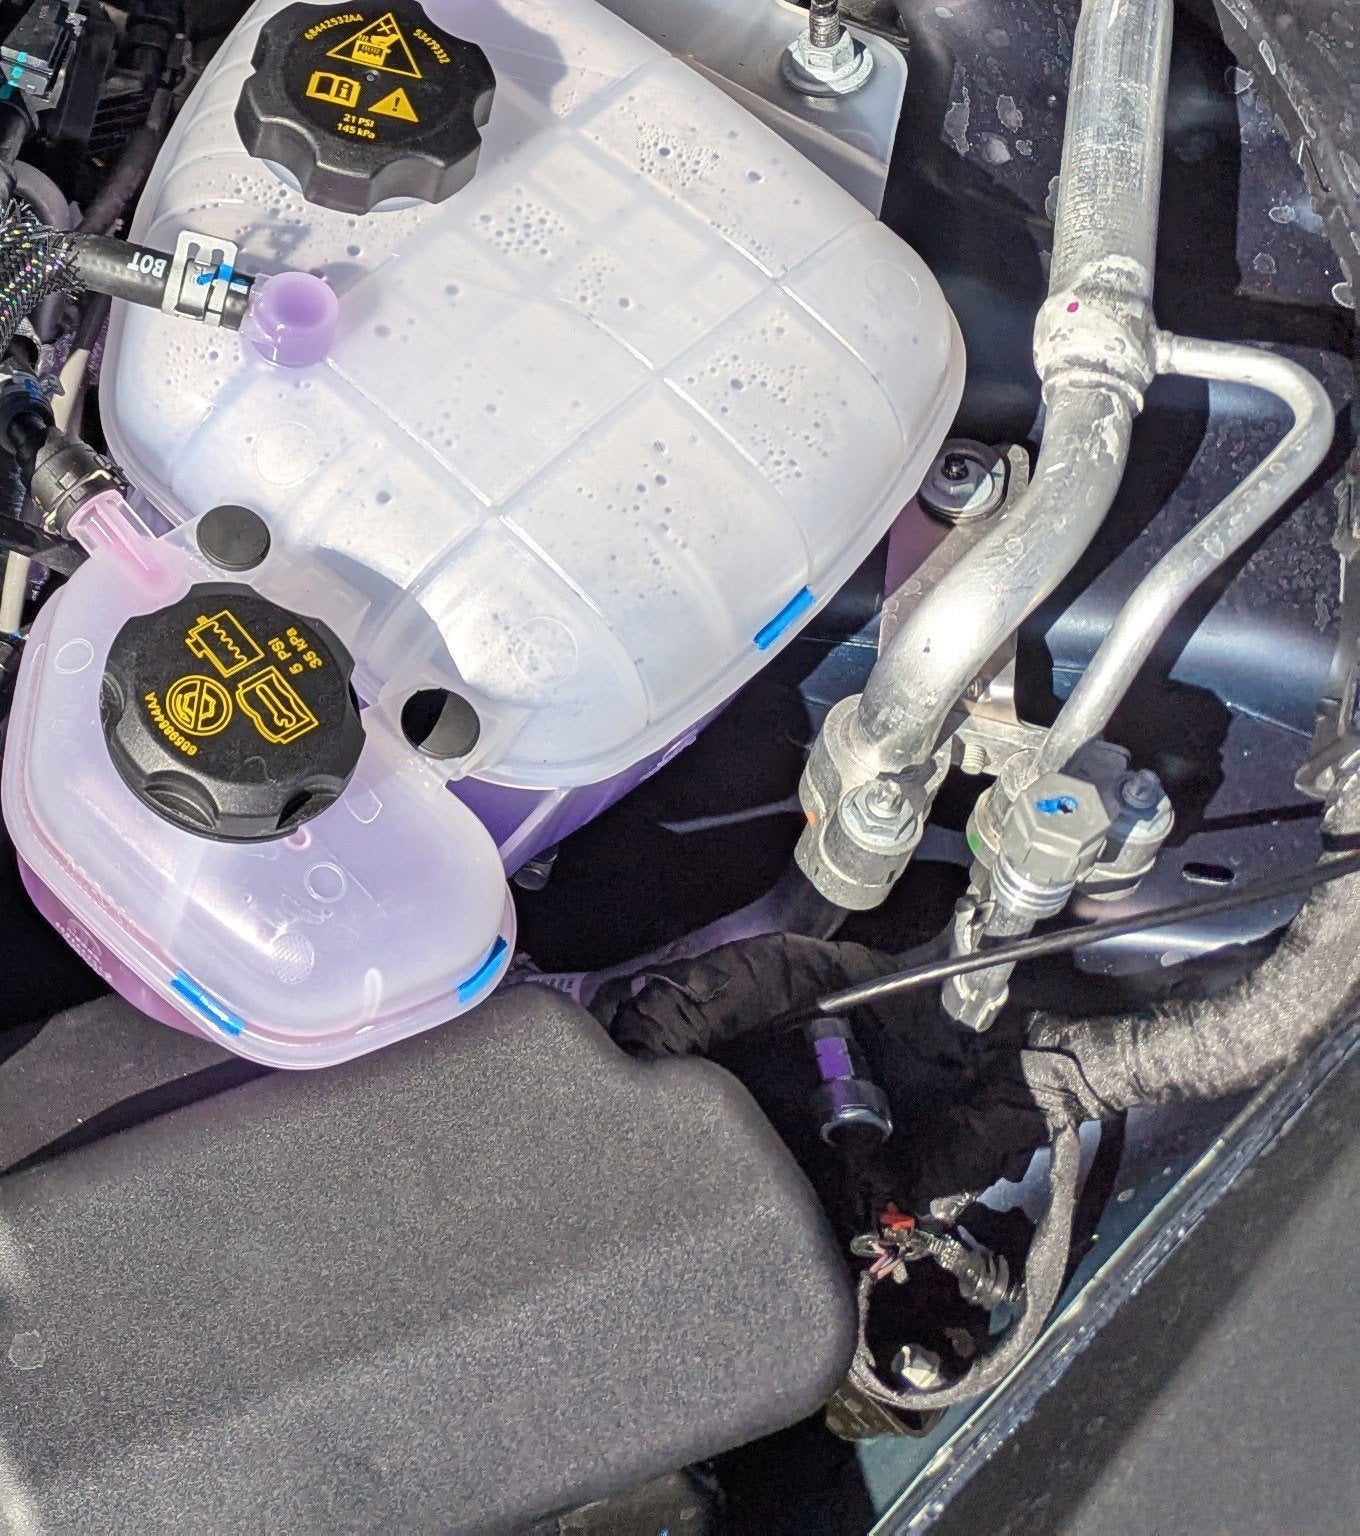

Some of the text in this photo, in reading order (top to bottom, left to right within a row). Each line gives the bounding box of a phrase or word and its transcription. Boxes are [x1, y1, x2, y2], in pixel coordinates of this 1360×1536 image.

[336, 122, 376, 140] 145 kPa
[343, 113, 375, 128] 21 PSI
[126, 251, 168, 279] BOT
[267, 637, 304, 675] 5 PSI
[302, 649, 324, 670] 35
